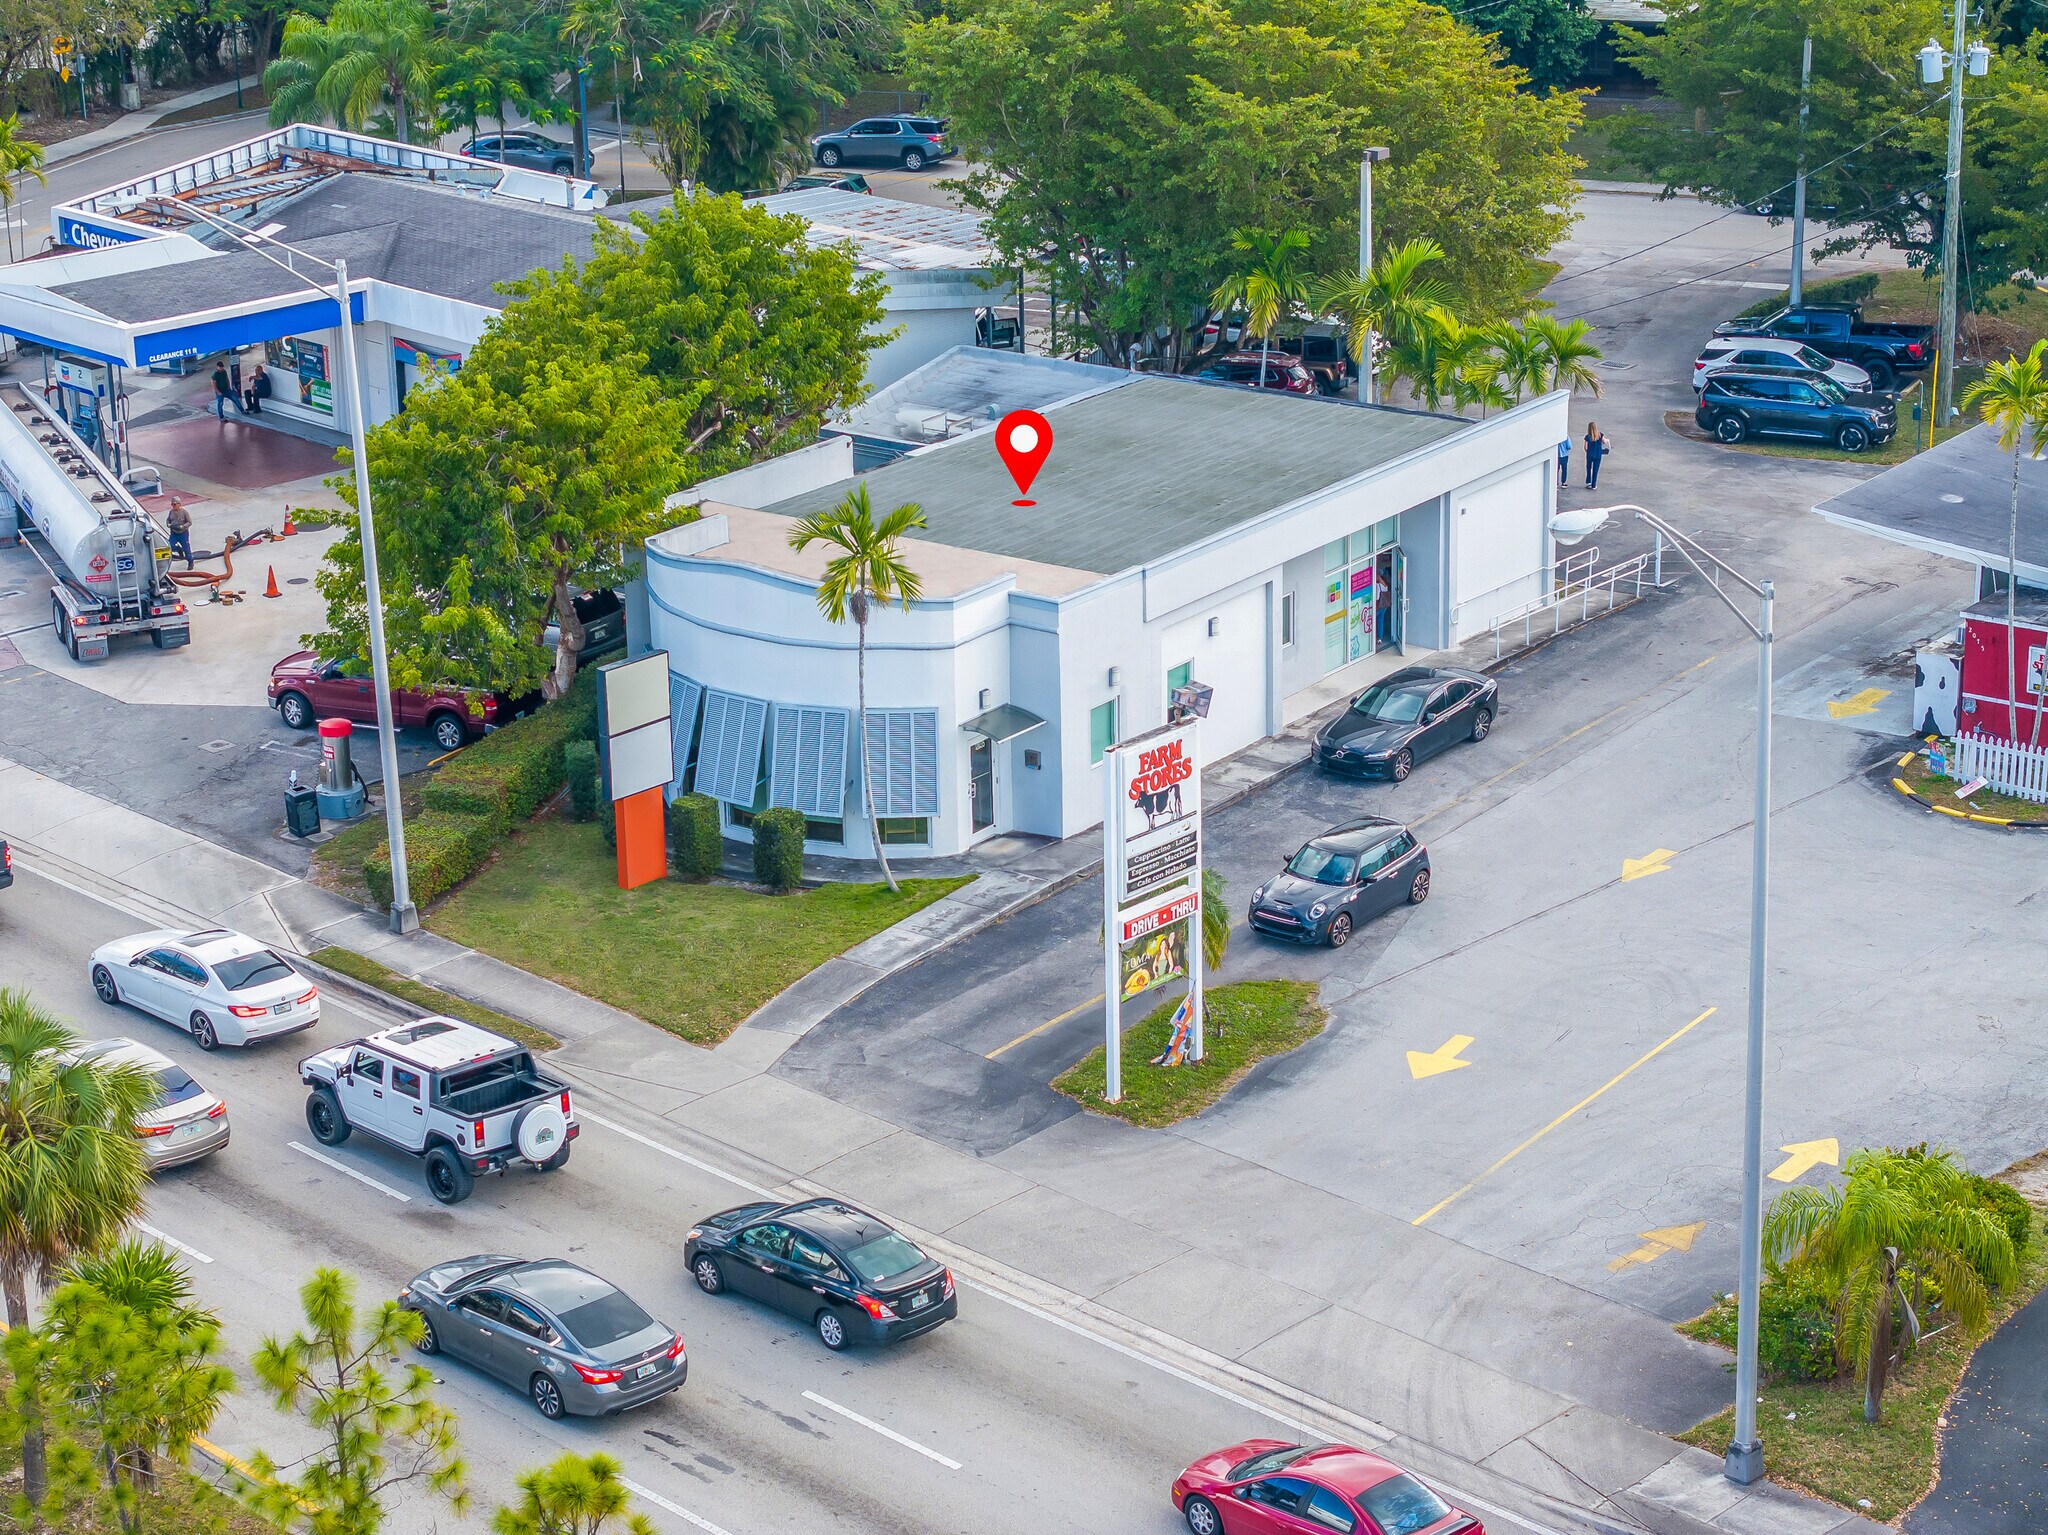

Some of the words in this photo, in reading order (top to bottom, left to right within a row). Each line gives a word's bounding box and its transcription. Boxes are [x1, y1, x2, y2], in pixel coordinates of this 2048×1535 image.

[71, 223, 127, 249] Chevro
[149, 349, 184, 363] CLEARANCE
[184, 348, 192, 356] 11
[77, 369, 83, 379] 2
[118, 540, 127, 549] 59
[1138, 738, 1183, 775] FARM
[1128, 757, 1193, 801] STORES
[1131, 862, 1160, 877] Espresso
[1164, 846, 1196, 864] Macchiato
[1134, 844, 1171, 863] Cappuccino
[1175, 836, 1191, 846] Latte
[1137, 877, 1152, 887] Cafe
[1152, 872, 1164, 881] con
[1165, 862, 1187, 875] Helado
[1131, 912, 1159, 937] DRIVE
[1170, 897, 1195, 920] THRU
